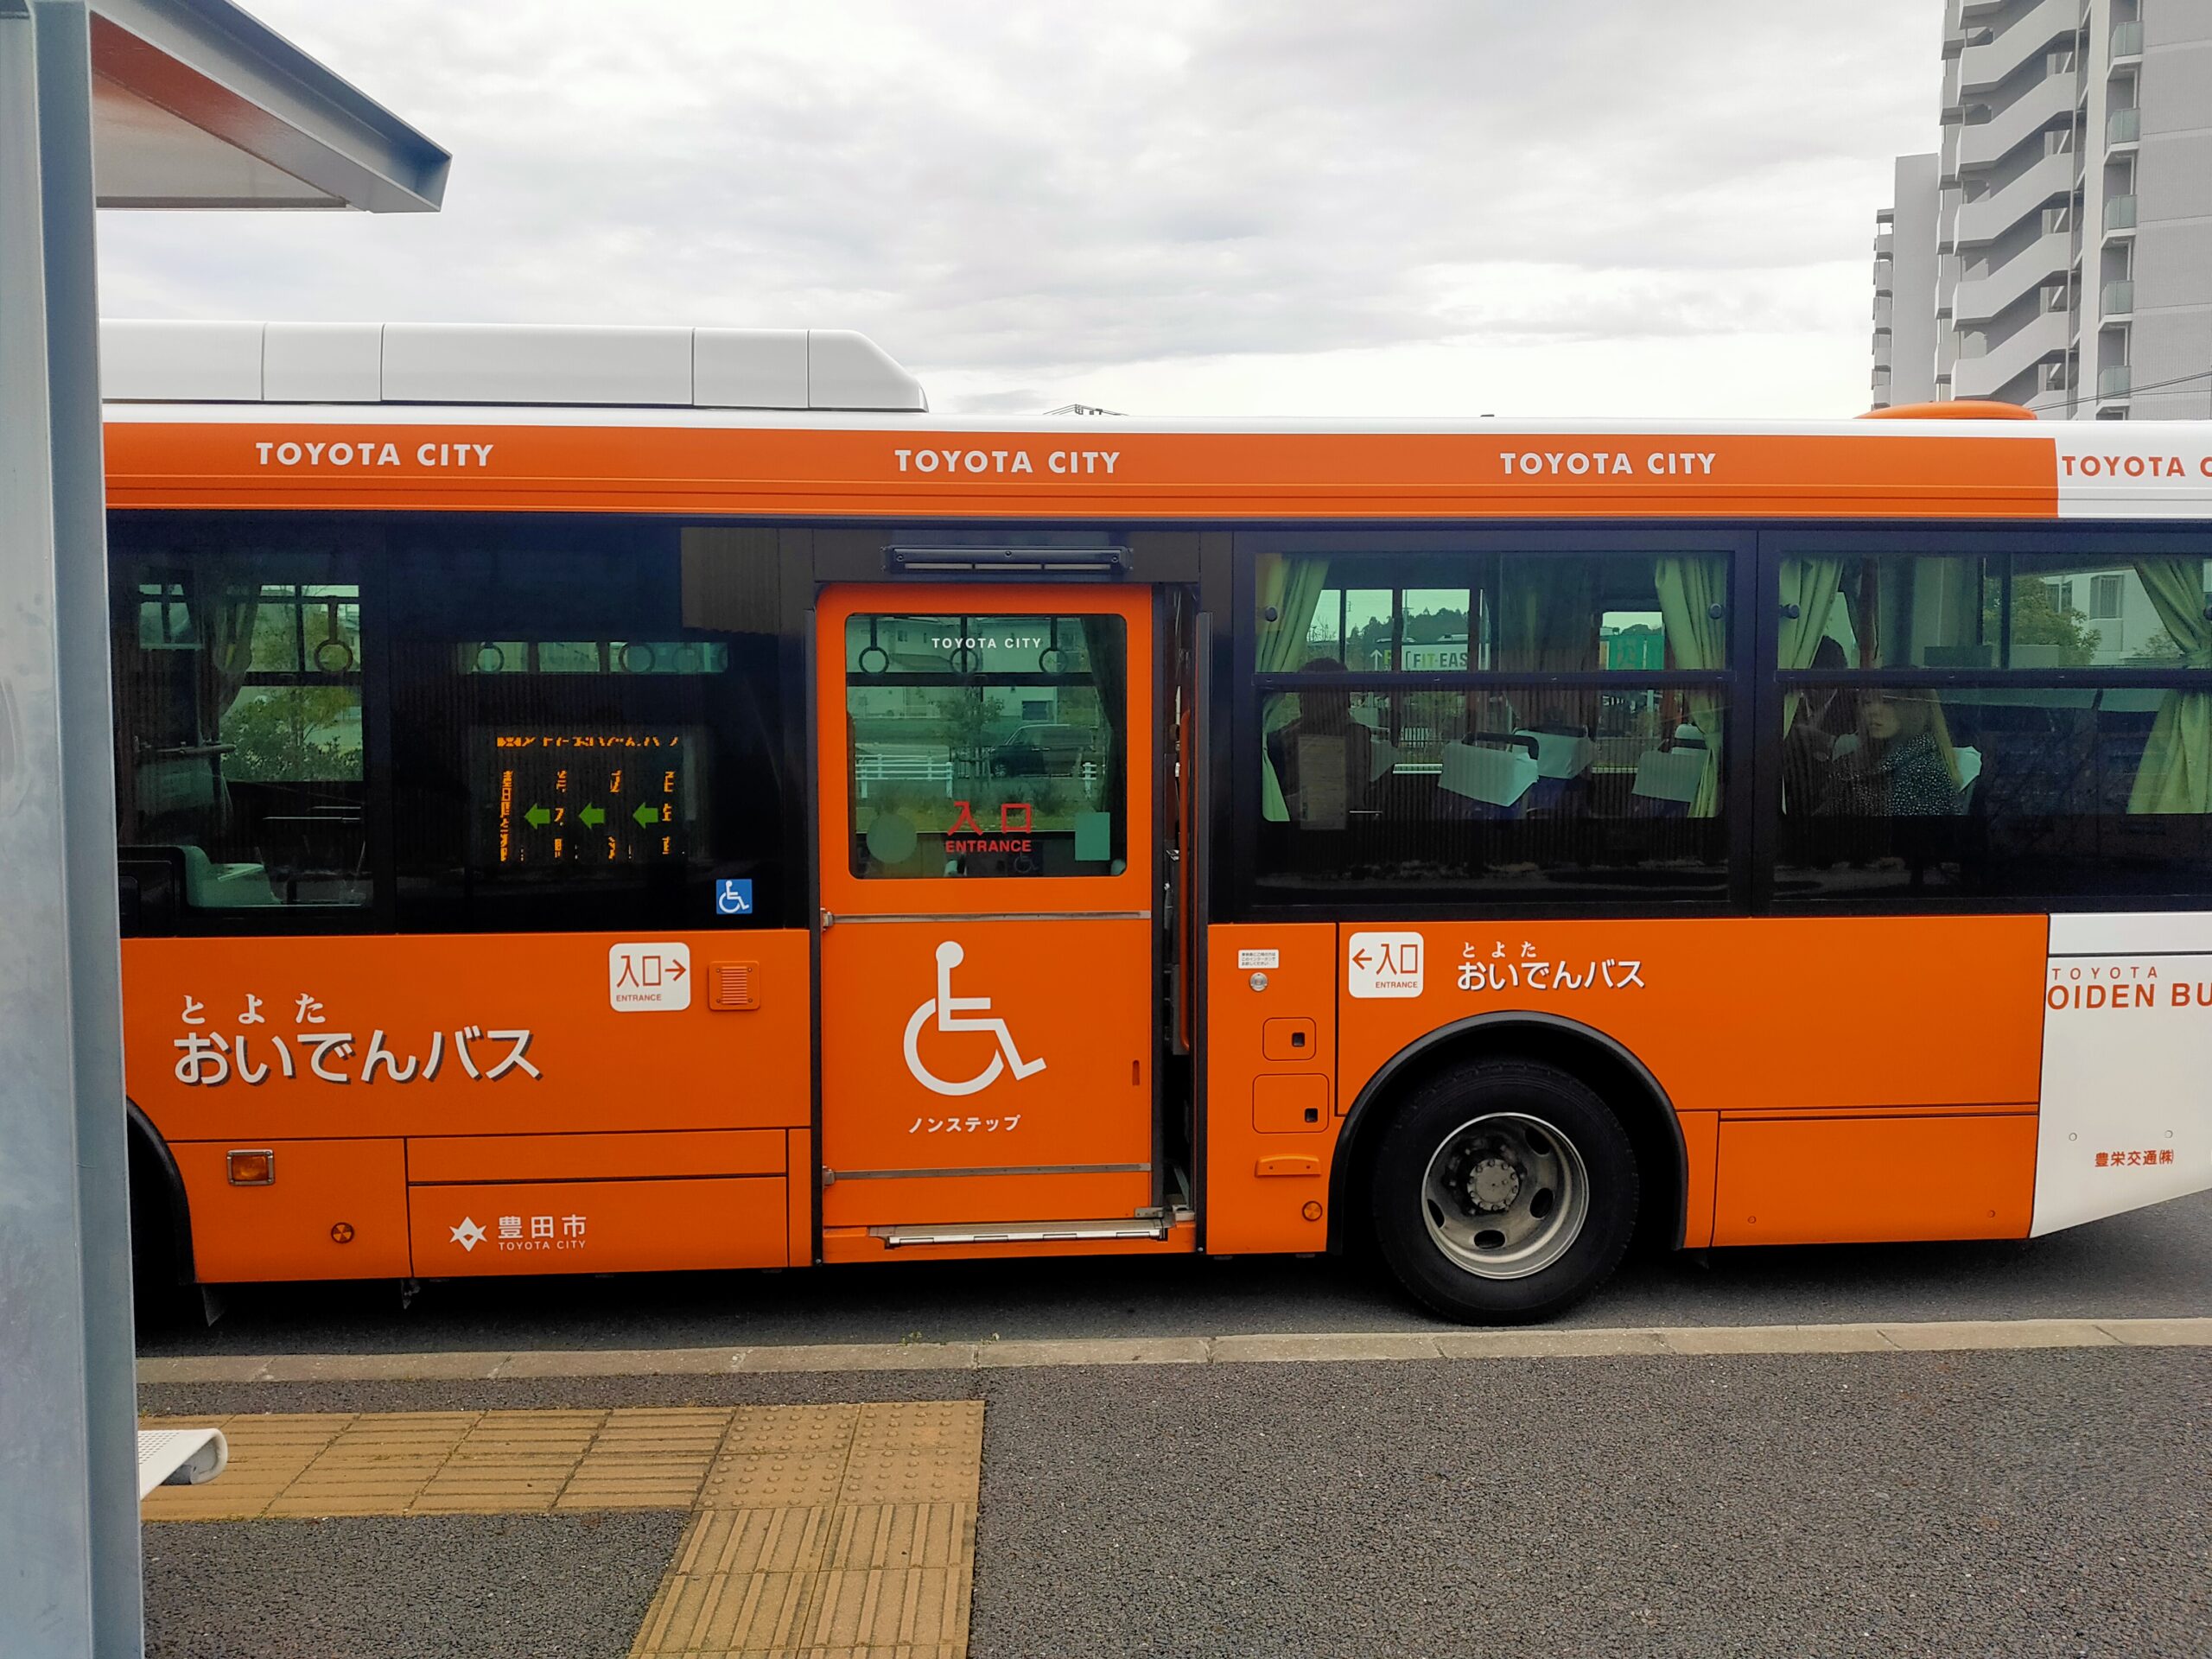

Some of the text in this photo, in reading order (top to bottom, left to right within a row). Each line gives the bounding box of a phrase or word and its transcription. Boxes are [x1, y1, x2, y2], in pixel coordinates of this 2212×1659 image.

[256, 442, 494, 467] TOYOTA CITY
[896, 450, 1122, 475] TOYOTA CITY
[1500, 453, 1717, 476] TOYOTA CITY
[2062, 456, 2186, 477] TOYOTA
[931, 638, 1041, 649] TOYOTA CITY
[946, 802, 1033, 836] 入口
[945, 840, 1032, 854] ENTRANCE
[1376, 944, 1418, 975] 入口
[1462, 941, 1537, 958] とよた
[617, 955, 661, 988] 入口
[1457, 958, 1645, 991] おいでんバス
[2051, 966, 2158, 981] TOYOTA
[2047, 982, 2212, 1010] OIDEN BU
[181, 993, 327, 1025] とよた
[174, 1025, 543, 1085] おいでんバス
[908, 1115, 1022, 1135] ノンステップ
[498, 1214, 587, 1238] 豊田市
[499, 1240, 586, 1251] TOYOTA CITY
